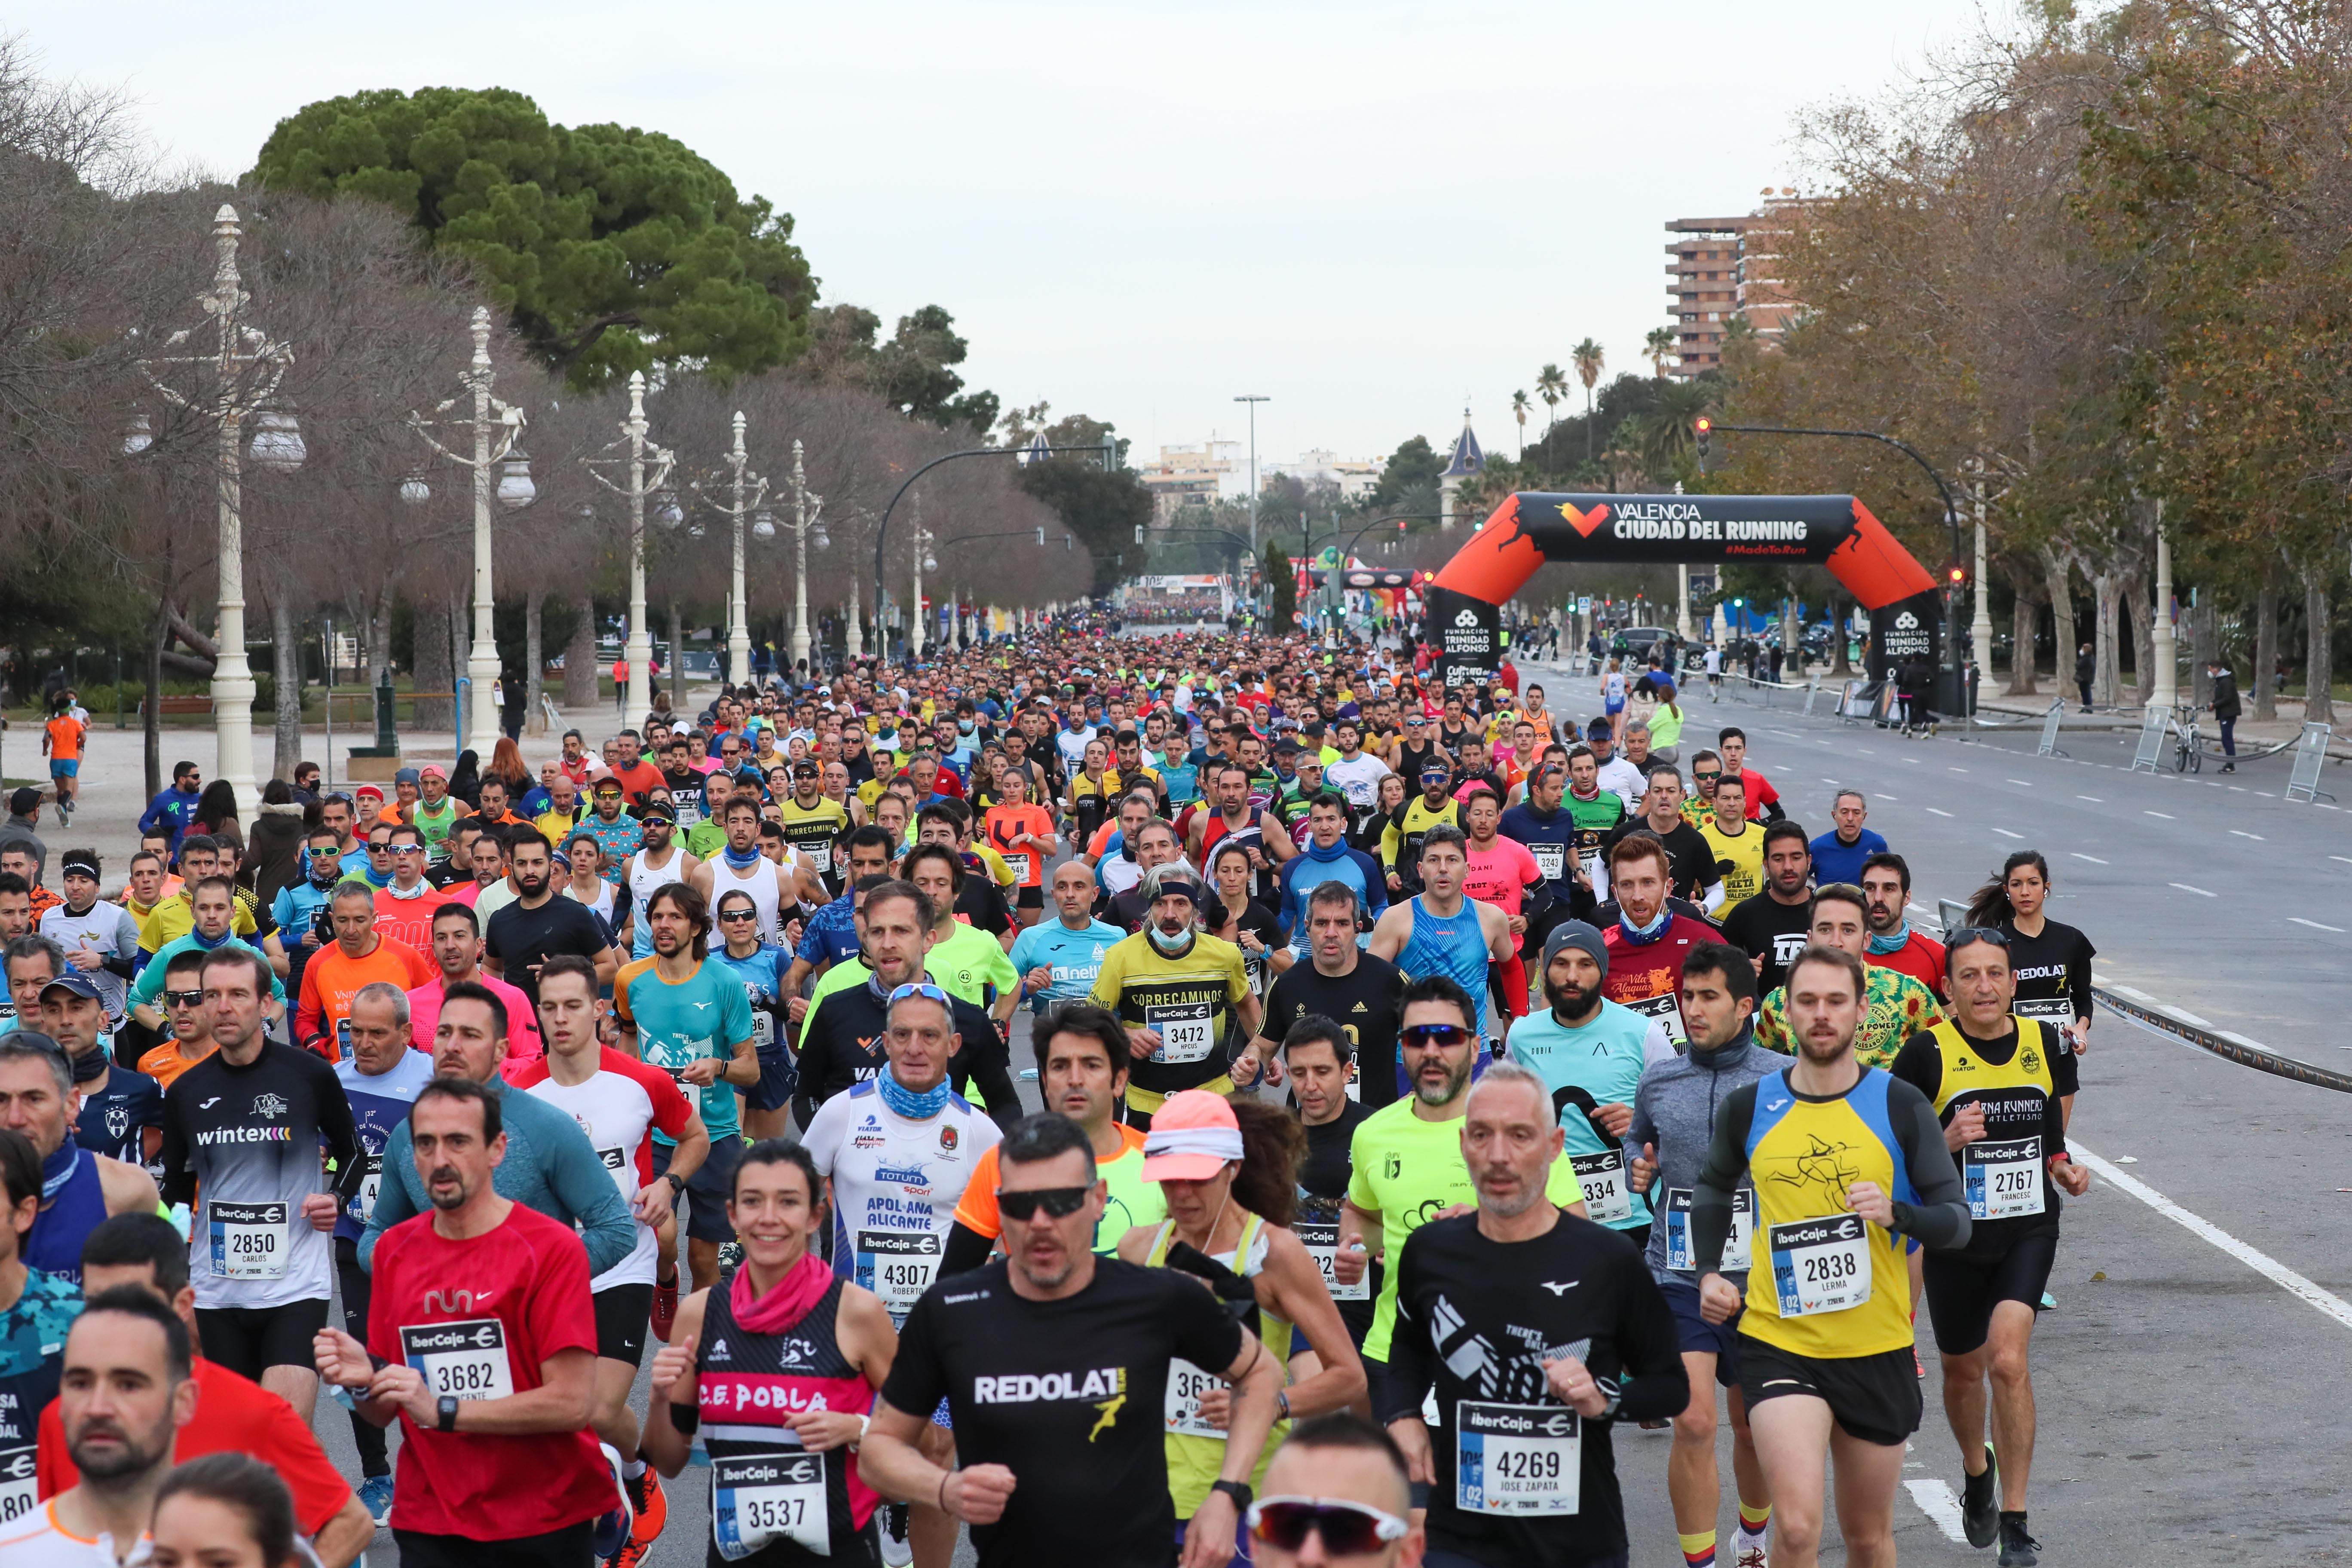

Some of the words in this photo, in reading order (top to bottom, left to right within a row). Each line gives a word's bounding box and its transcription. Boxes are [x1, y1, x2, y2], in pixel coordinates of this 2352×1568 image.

[1614, 503, 1701, 520] VALENCIA
[1614, 521, 1685, 539] CIUDAD
[1689, 521, 1722, 539] DEL
[1726, 522, 1807, 540] RUNNING
[1726, 545, 1806, 554] #MadeToRun
[1445, 636, 1489, 644] TRINIDAD
[1885, 638, 1929, 646] TRINIDAD
[1446, 644, 1489, 652] ALFONSO
[1886, 646, 1929, 655] ALFONSO
[1541, 858, 1559, 867] 3243
[1727, 879, 1754, 888] META
[1630, 973, 1647, 984] Vila
[1132, 990, 1222, 1008] CORRECAMINOS
[1154, 1010, 1189, 1020] iberCaja
[2022, 1005, 2053, 1014] iberCaja
[1867, 1023, 1896, 1031] POWER
[1171, 1027, 1204, 1044] 3472
[1154, 1050, 1164, 1058] 02
[2004, 1099, 2043, 1114] RUNNERS
[1989, 1112, 2042, 1122] ATLETISMO
[1974, 1148, 2018, 1160] iberCaja
[1996, 1170, 2033, 1192] 2767
[904, 1185, 930, 1196] sport
[2001, 1191, 2030, 1201] FRANCESC
[867, 1198, 901, 1213] APOL
[906, 1200, 933, 1216] ANA
[1972, 1202, 1985, 1213] 02
[217, 1208, 255, 1221] iberCaja
[867, 1214, 931, 1230] ALICANTE
[1778, 1228, 1828, 1244] iberCaja
[233, 1234, 275, 1254] 2850
[865, 1237, 910, 1251] iberCaja
[1674, 1251, 1685, 1262] 02
[215, 1260, 225, 1270] 02
[1805, 1253, 1856, 1282] 2838
[885, 1265, 929, 1285] 4307
[1822, 1280, 1847, 1292] LERMA
[424, 1290, 472, 1314] run
[1787, 1297, 1799, 1308] 02
[1506, 1324, 1543, 1340] THERE'S
[411, 1333, 465, 1348] iberCaja
[1524, 1338, 1549, 1351] ONLY
[438, 1363, 494, 1392] 3682
[975, 1367, 1118, 1403] REDOLAT
[736, 1384, 827, 1412] POBLA
[1471, 1412, 1533, 1432] iberCaja
[1497, 1451, 1560, 1479] 4269
[723, 1466, 778, 1481] iberCaja
[1501, 1481, 1522, 1491] JOSE
[1525, 1481, 1559, 1491] ZAPATA
[1466, 1486, 1482, 1502] 02
[748, 1499, 805, 1528] 3537
